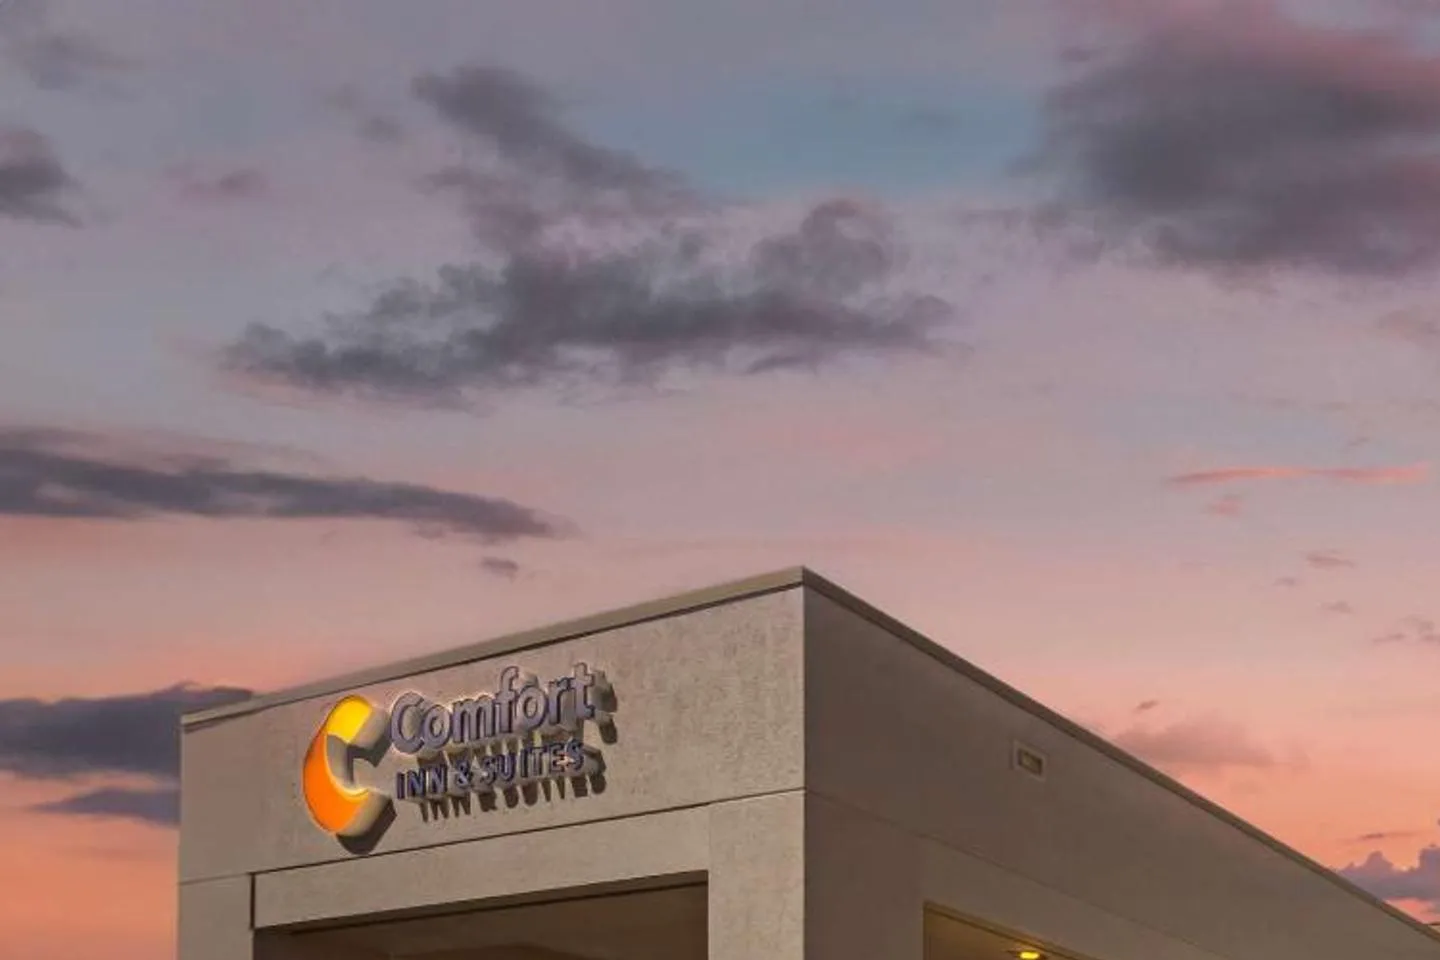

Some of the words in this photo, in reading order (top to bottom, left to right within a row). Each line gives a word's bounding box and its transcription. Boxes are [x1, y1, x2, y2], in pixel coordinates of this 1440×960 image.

[389, 662, 596, 754] Comfort
[396, 763, 448, 800] INN
[454, 757, 474, 789] &
[481, 738, 584, 785] SUITES
